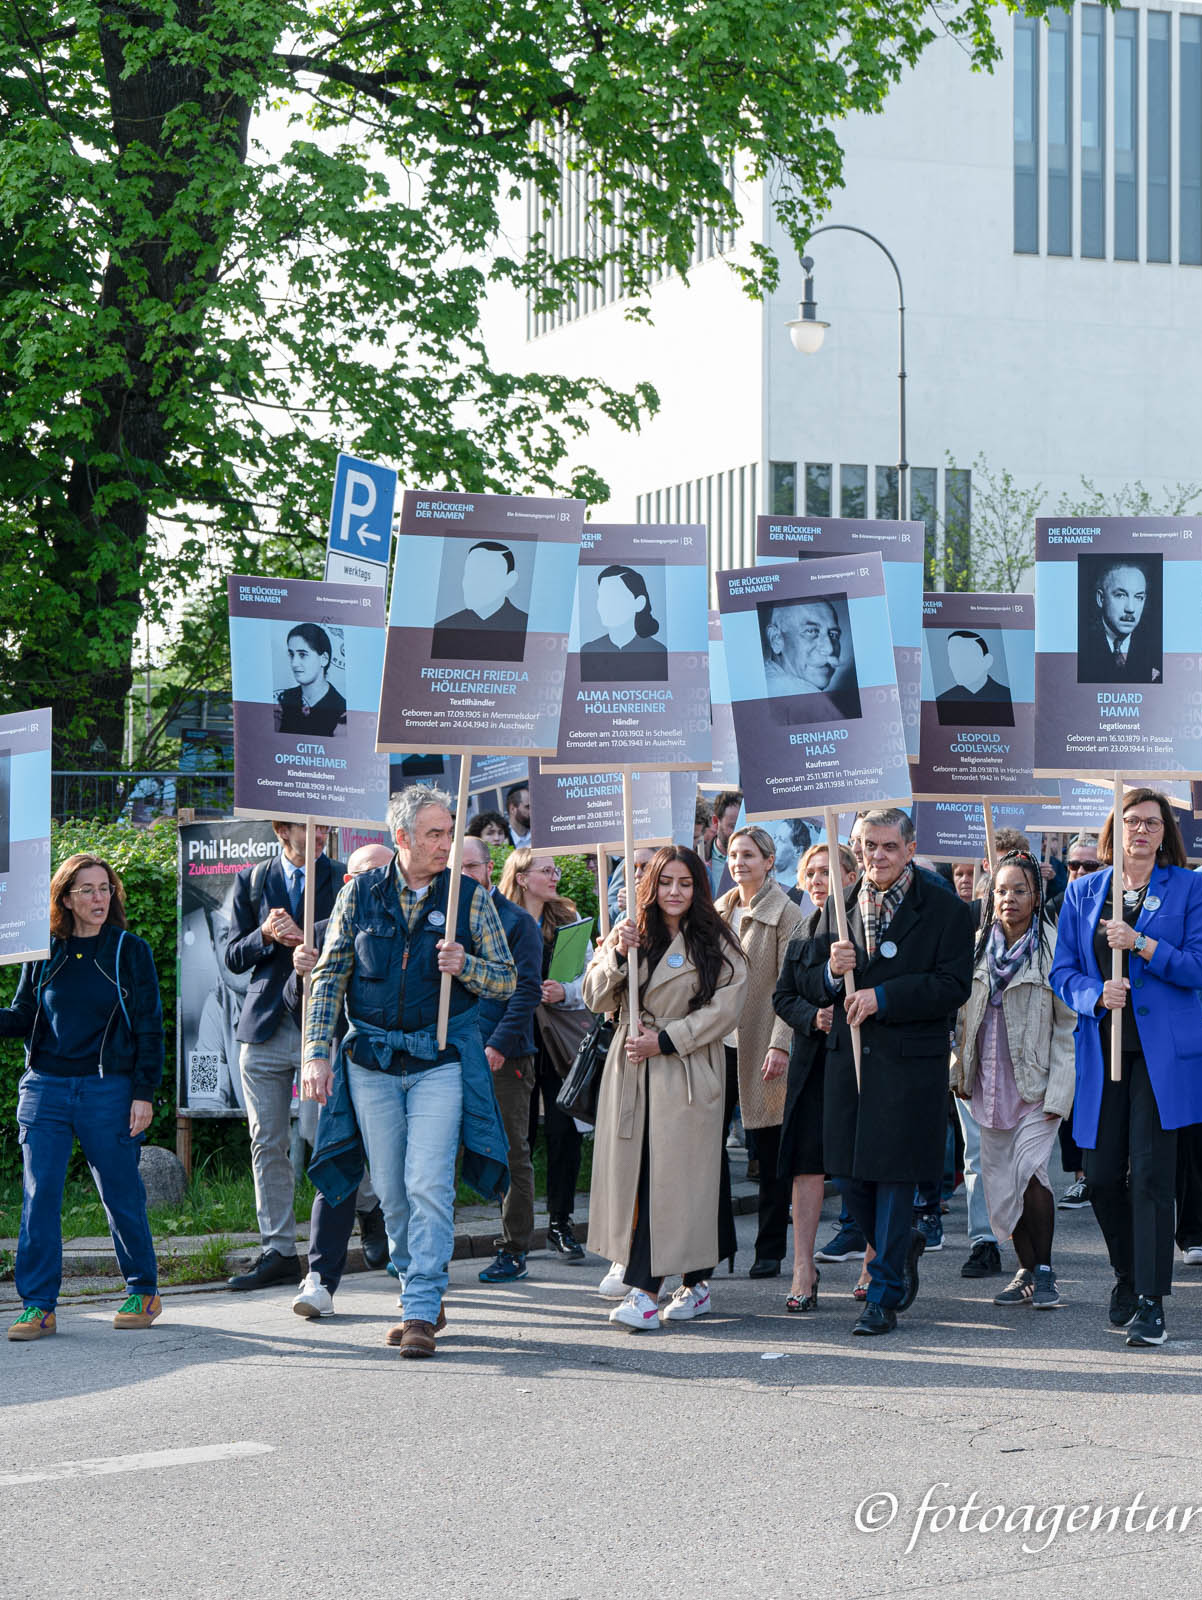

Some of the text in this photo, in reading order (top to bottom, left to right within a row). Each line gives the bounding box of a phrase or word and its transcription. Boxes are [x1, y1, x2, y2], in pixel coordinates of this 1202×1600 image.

[340, 469, 376, 540] P
[431, 501, 474, 512] RÜCKKEHR
[433, 511, 464, 520] NAMEN
[1062, 526, 1101, 535] RÜCKKEHR
[344, 565, 371, 582] werktags
[729, 575, 780, 587] DIE RÜCKKEHR
[252, 586, 288, 596] RÜCKKEHR
[730, 584, 773, 595] DER NAMEN
[254, 595, 281, 603] NAMEN
[421, 668, 528, 681] FRIEDRICH FRIEDLA
[431, 681, 516, 694] HÖLLENREINER
[577, 690, 673, 701] ALMA NOTSCHGA
[1098, 693, 1142, 703] EDUARD
[585, 701, 665, 713] HÖLLENREINER
[1101, 706, 1139, 717] HAMM
[1099, 722, 1140, 732] Legationsrat
[790, 729, 848, 744] BERNHARD
[957, 733, 1000, 742] LEOPOLD
[297, 743, 325, 755] GITTA
[806, 744, 836, 756] HAAS
[950, 744, 1010, 753] GODLEWSKY
[275, 754, 347, 768] OPPENHEIMER
[806, 760, 839, 768] Kaufmann
[557, 776, 588, 788] MARIA
[772, 785, 802, 794] Ermordet
[854, 777, 878, 786] Dachau
[566, 784, 624, 799] HÖLLENREIN
[936, 803, 1024, 815] MARGOT BETA ERIKA
[964, 814, 996, 822] WIENR
[188, 840, 217, 860] Phil
[188, 862, 256, 876] Zukunftsmach
